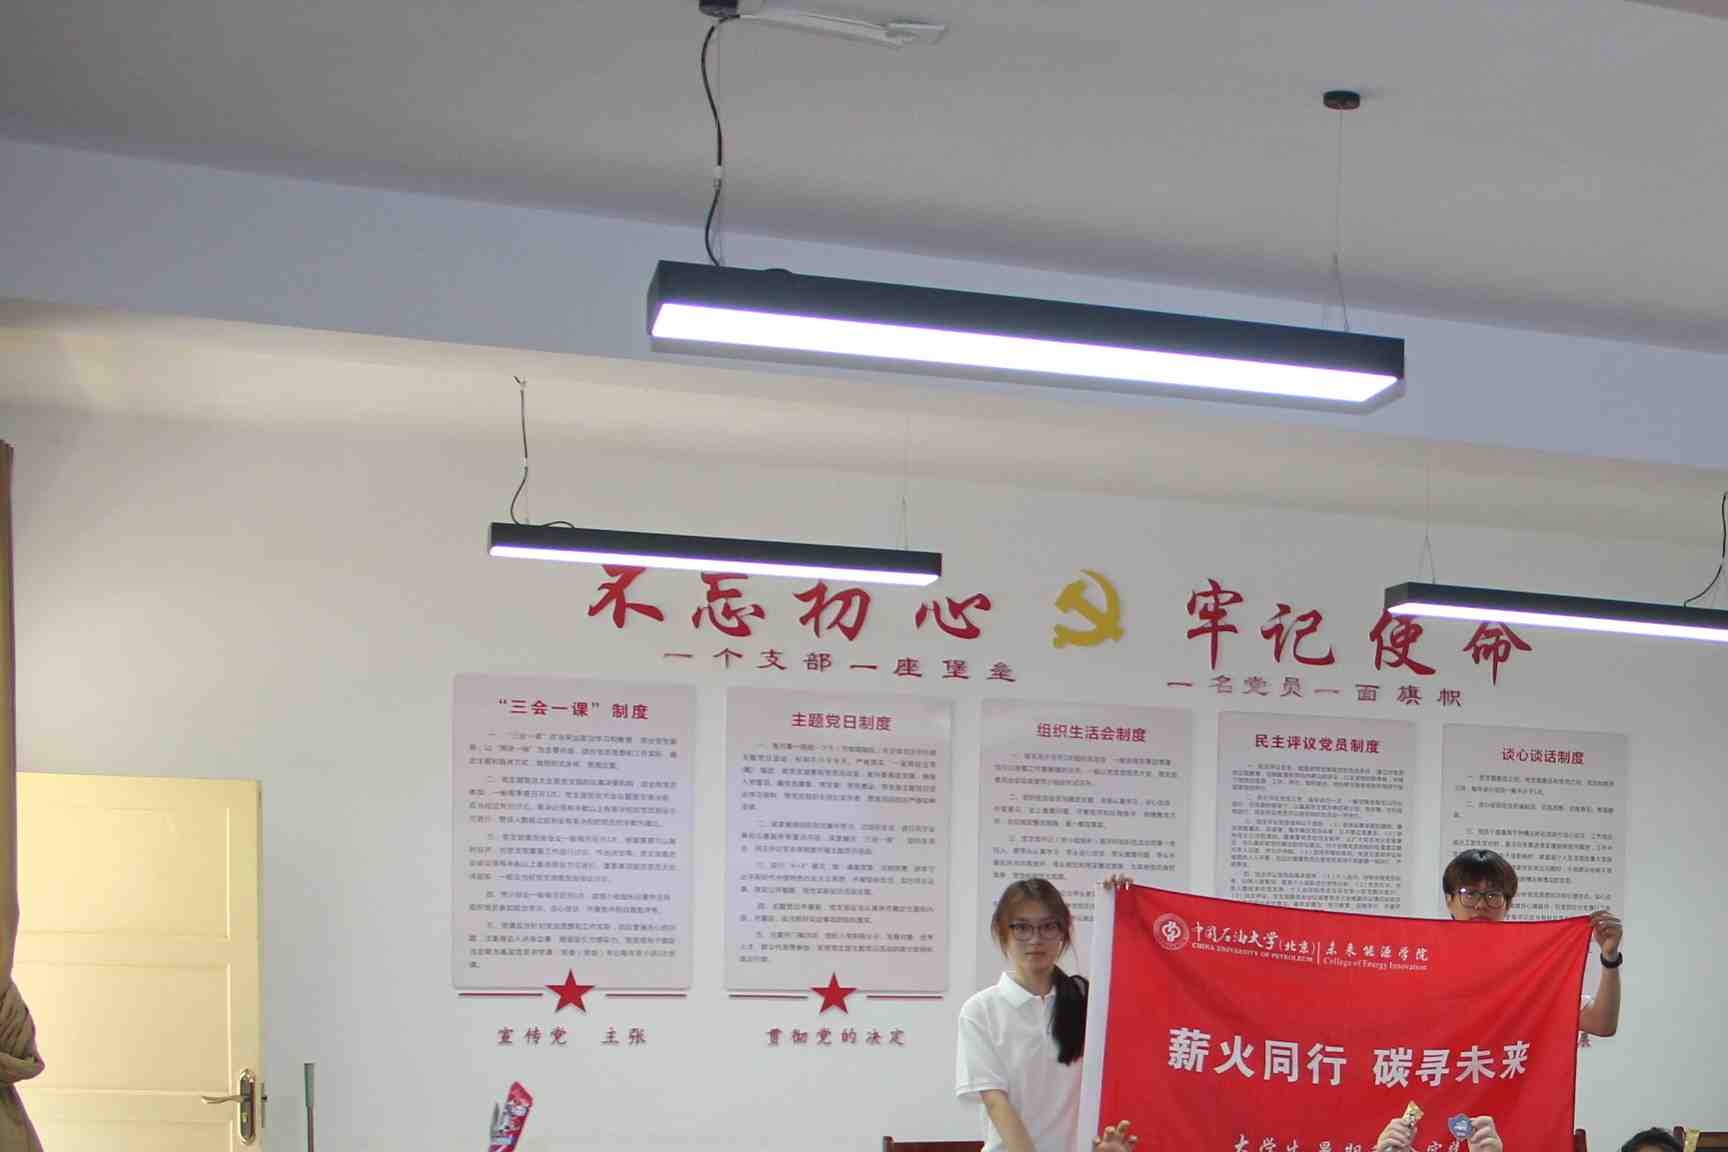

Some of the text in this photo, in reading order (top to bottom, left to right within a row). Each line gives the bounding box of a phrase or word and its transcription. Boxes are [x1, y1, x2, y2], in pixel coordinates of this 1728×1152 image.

[589, 565, 992, 641] 不忘初心
[1187, 578, 1532, 687] 牢记使命
[662, 647, 1017, 682] 一个支部一座堡垒
[1166, 674, 1466, 707] 一名党员一面旗帜
[611, 703, 650, 720] 制度
[791, 711, 893, 732] 主题党日制度
[1036, 722, 1147, 743] 组织生活会制度
[1255, 733, 1381, 754] 民主评议党员制度
[1502, 747, 1585, 766] 谈心谈话制度
[765, 1027, 905, 1046] 贯彻党的决定
[1168, 1026, 1531, 1089] 薪火同行 碳寻未来
